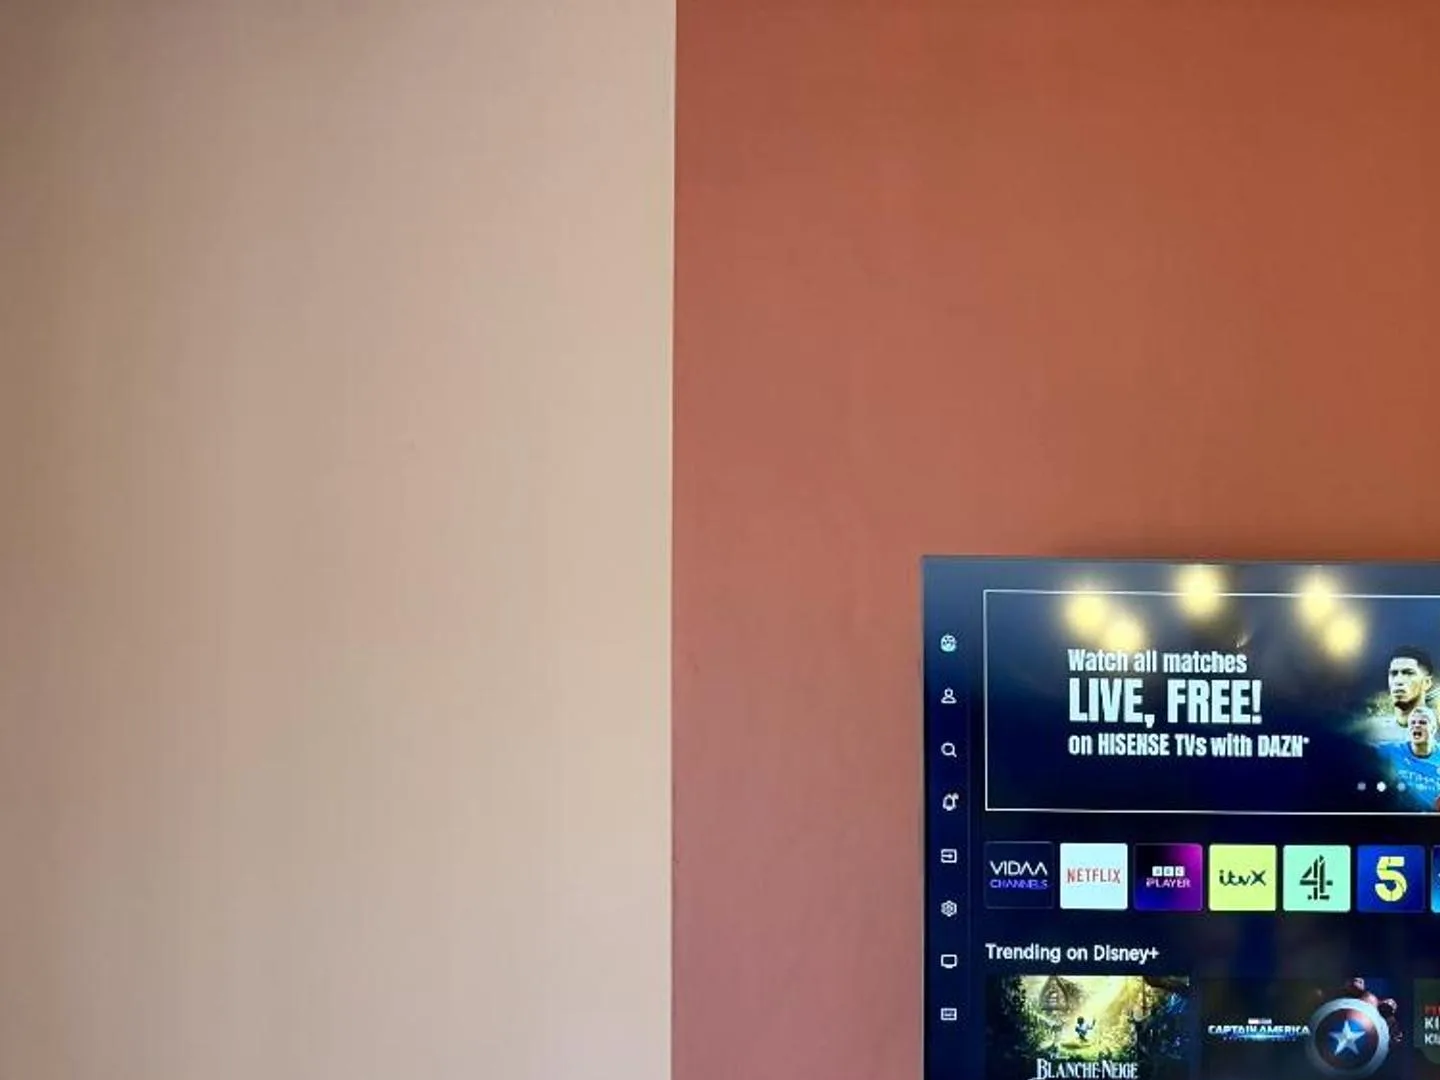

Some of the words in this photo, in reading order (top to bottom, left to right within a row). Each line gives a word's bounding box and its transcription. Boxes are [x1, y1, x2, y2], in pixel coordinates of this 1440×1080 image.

[1068, 649, 1128, 672] Watch
[1134, 650, 1157, 673] all
[1163, 651, 1248, 674] matches
[1069, 678, 1155, 728] LIVE,
[1167, 679, 1263, 725] FREE!
[1068, 735, 1093, 756] on
[1098, 733, 1170, 756] HISENSE
[1175, 734, 1207, 757] TVs
[1211, 733, 1252, 758] with
[990, 861, 1048, 876] VIDAA
[1067, 868, 1121, 884] NETFLIX
[1375, 856, 1407, 901] 5
[985, 943, 1061, 963] Trending
[1067, 947, 1088, 960] on
[1094, 945, 1159, 965] Disney+
[1208, 1025, 1257, 1035] CAPTAIN
[1260, 1025, 1311, 1036] AMERICA
